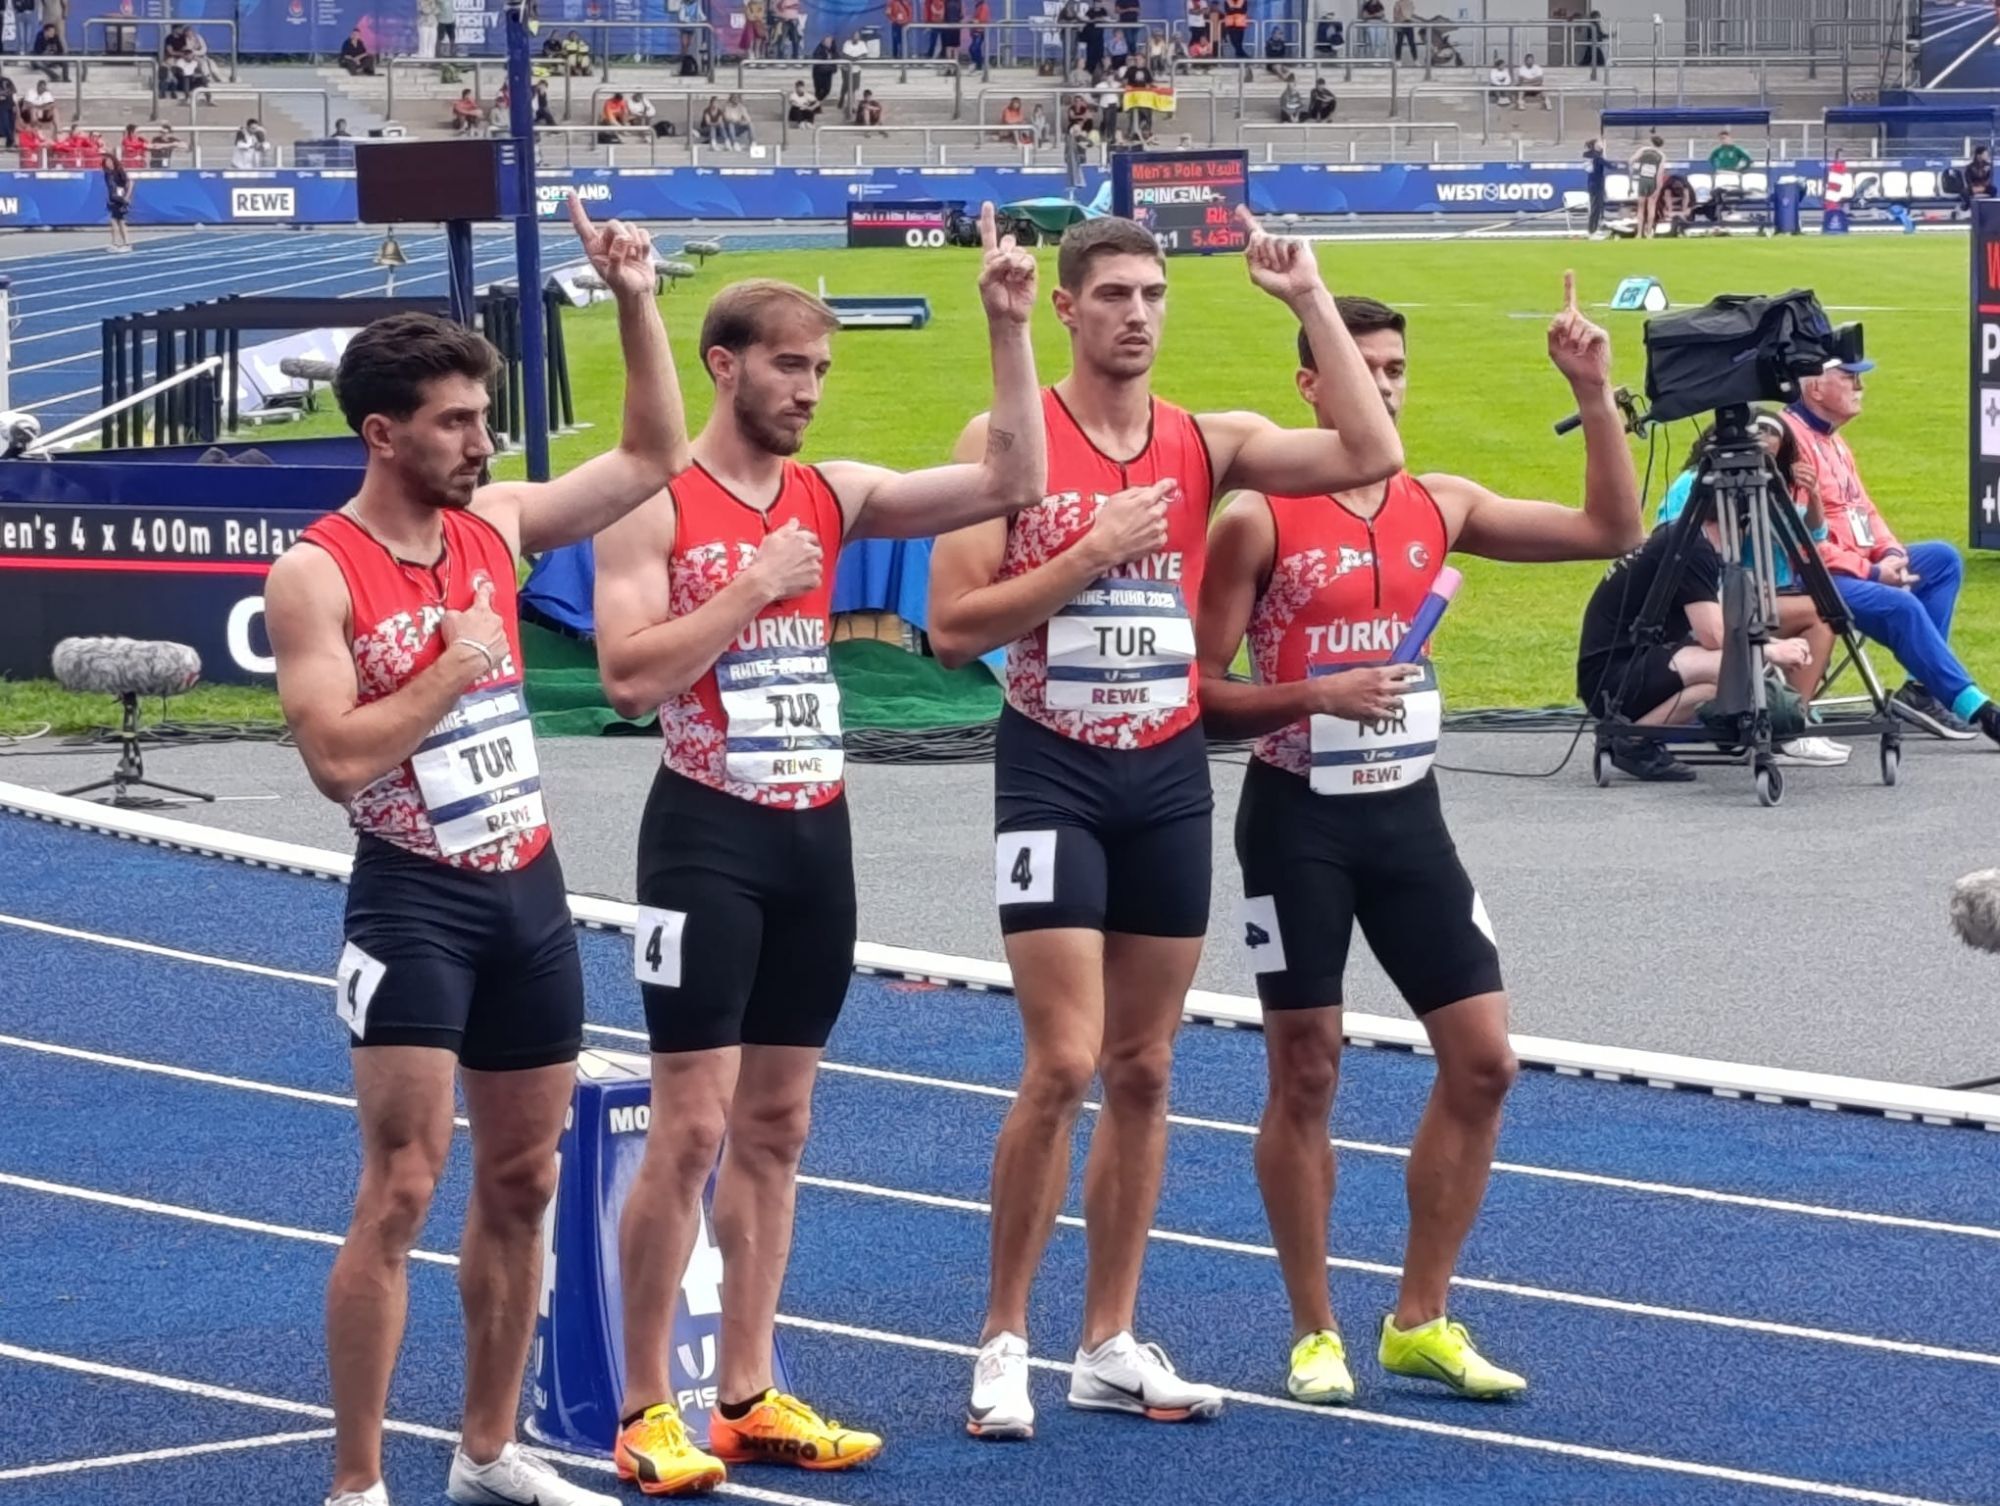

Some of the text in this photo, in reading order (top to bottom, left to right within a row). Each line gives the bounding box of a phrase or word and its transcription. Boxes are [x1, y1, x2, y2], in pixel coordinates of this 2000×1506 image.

[236, 193, 290, 211] REWE
[906, 228, 945, 247] 0.0
[3, 514, 57, 550] en's
[71, 516, 87, 551] 4
[102, 524, 117, 551] x
[131, 518, 212, 555] 400m
[1093, 626, 1156, 656] TUR
[766, 692, 822, 728] TUR
[1091, 687, 1150, 705] REWE
[459, 736, 518, 785] TUR
[1010, 847, 1033, 891] 4
[645, 925, 664, 973] 4
[1245, 921, 1271, 949] 4
[347, 968, 363, 1016] 4
[609, 1105, 651, 1134] MO
[677, 1386, 718, 1413] FIS
